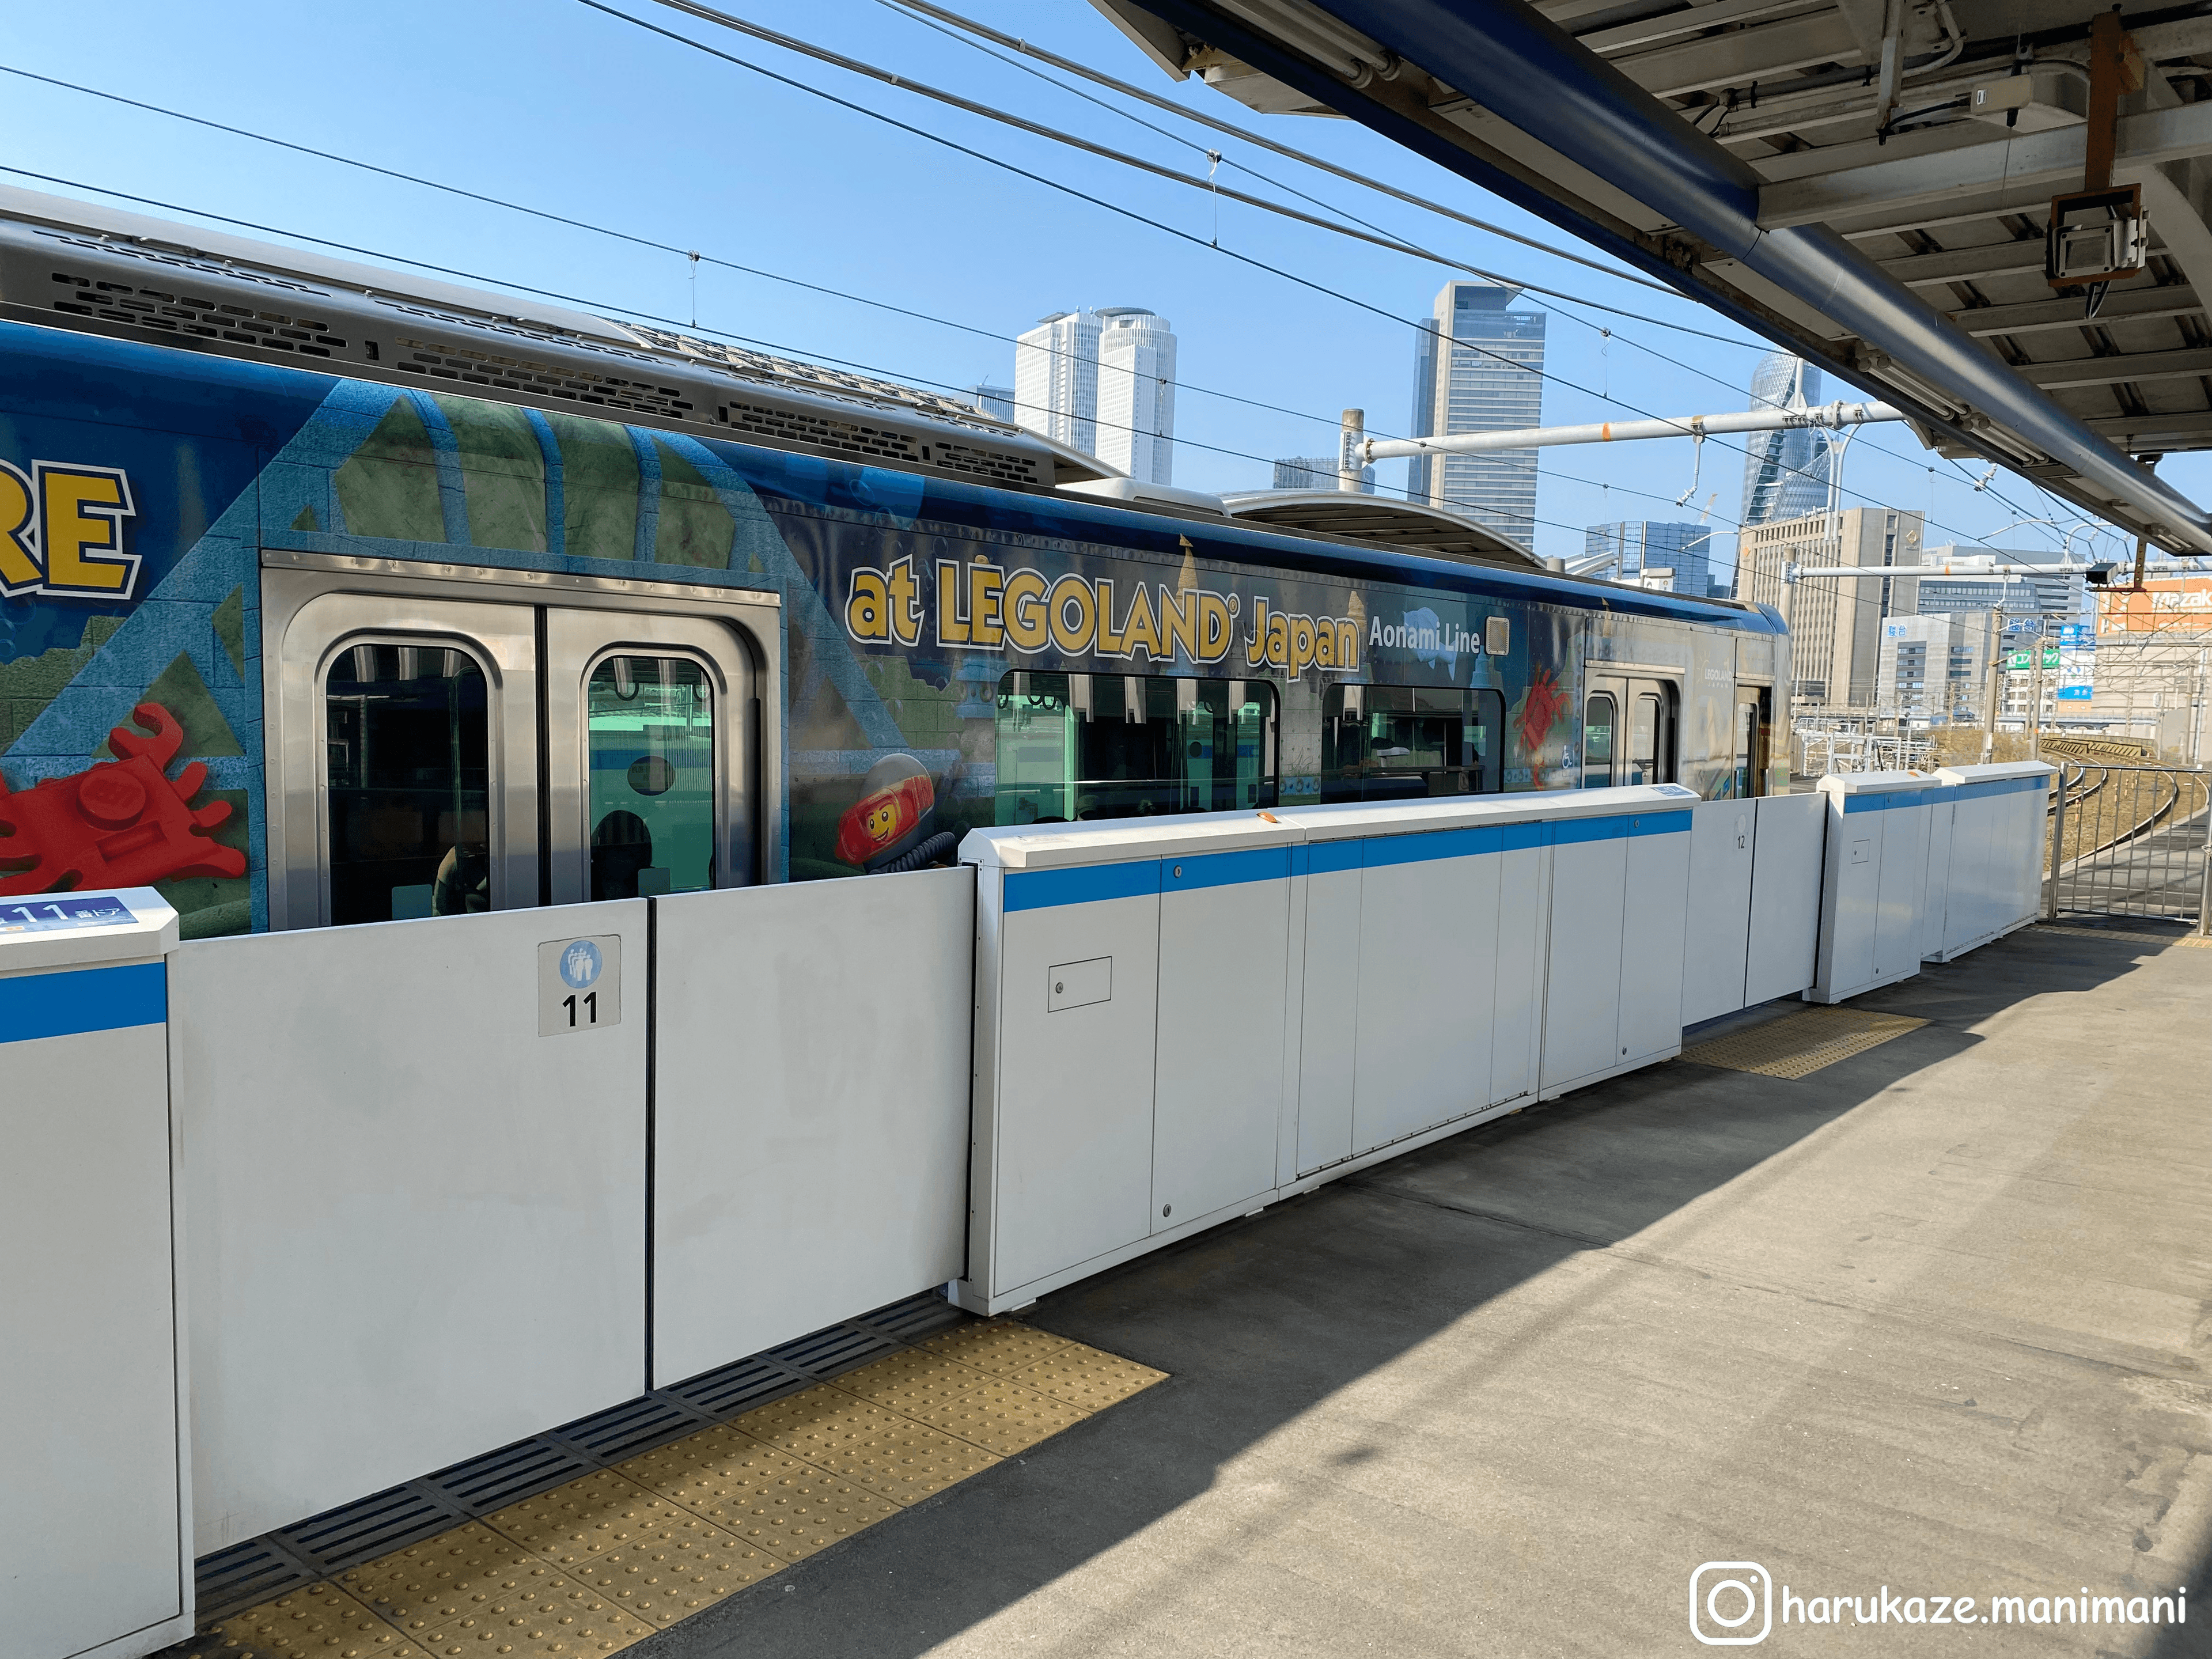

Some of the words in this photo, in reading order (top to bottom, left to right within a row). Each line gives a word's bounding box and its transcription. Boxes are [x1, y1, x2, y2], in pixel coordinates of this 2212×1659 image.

[845, 554, 925, 646] at
[1244, 596, 1360, 683] Japan
[1369, 616, 1440, 650] Aonami
[1445, 623, 1480, 653] Line
[1705, 668, 1732, 681] LEGOLAND
[1737, 835, 1745, 849] 12
[562, 991, 597, 1027] 11
